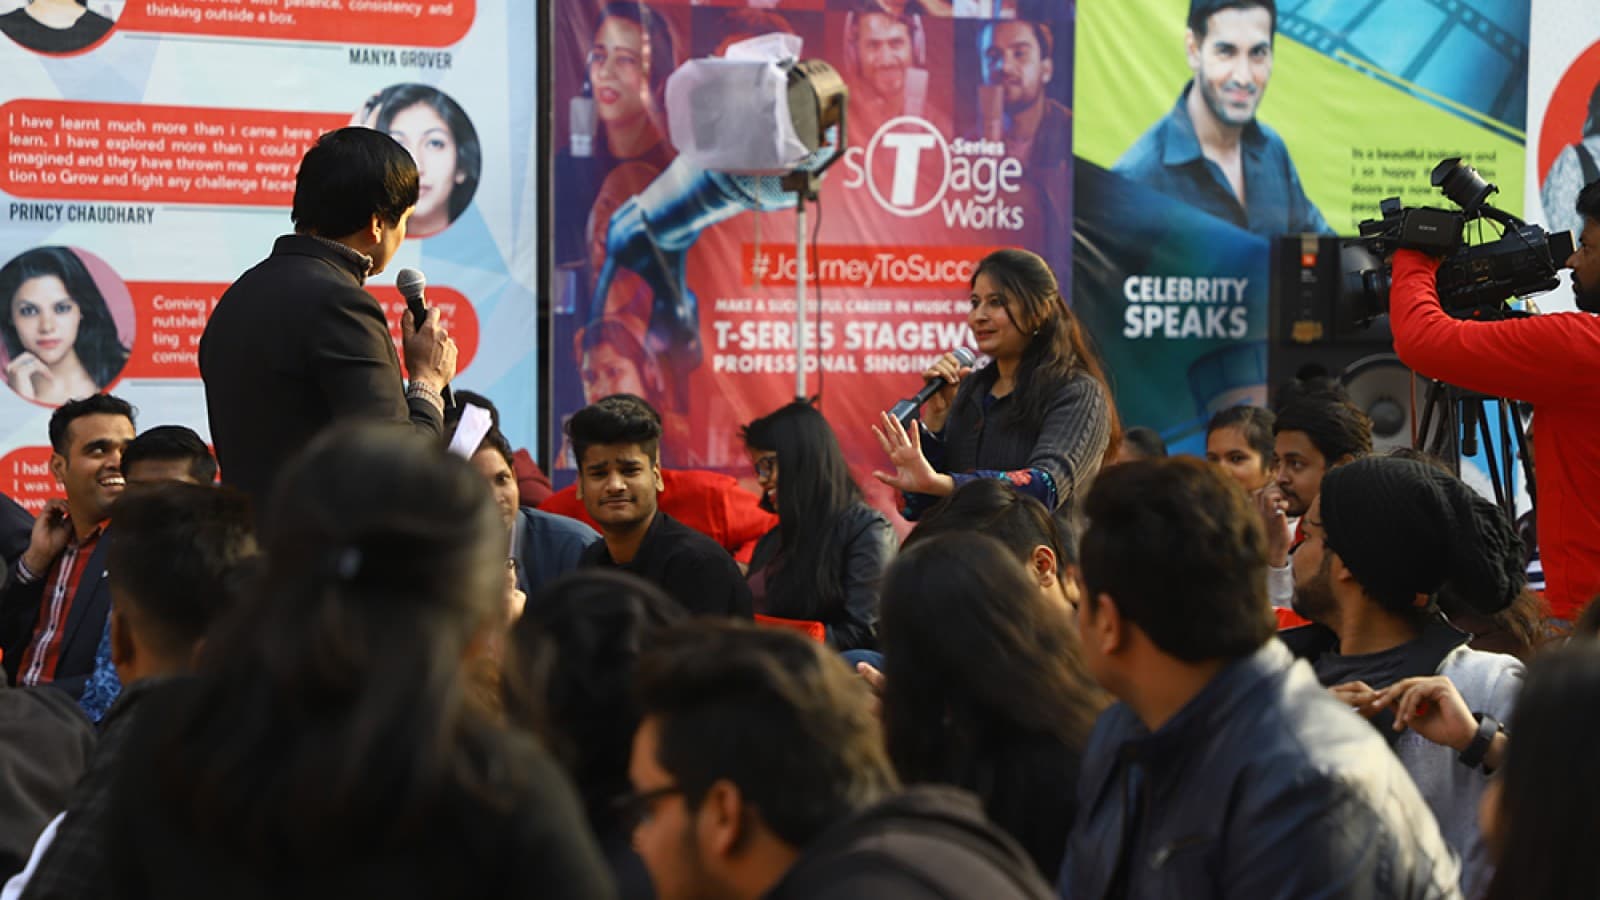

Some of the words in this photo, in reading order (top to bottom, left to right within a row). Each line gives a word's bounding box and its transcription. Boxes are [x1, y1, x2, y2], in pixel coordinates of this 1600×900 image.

[146, 3, 202, 23] thinking
[205, 8, 255, 23] outside
[257, 12, 266, 23] a
[268, 9, 297, 25] box.
[428, 4, 453, 15] and
[349, 48, 397, 66] MANYA
[400, 51, 453, 69] GROVER
[9, 112, 14, 127] I
[21, 113, 54, 129] have
[60, 115, 100, 131] learnt
[107, 118, 146, 133] much
[152, 122, 187, 135] more
[194, 122, 224, 136] than
[231, 122, 235, 136] i
[241, 127, 277, 138] came
[283, 126, 312, 139] here
[9, 131, 48, 147] learn.
[67, 133, 99, 149] have
[106, 137, 166, 154] explored
[171, 140, 206, 153] more
[213, 140, 242, 155] than
[260, 143, 296, 157] could
[9, 152, 74, 169] imagined
[77, 154, 103, 167] and
[107, 154, 137, 171] they
[141, 155, 173, 170] have
[176, 157, 223, 171] thrown
[227, 161, 248, 172] me
[255, 162, 289, 177] every
[9, 169, 37, 183] tion
[41, 170, 56, 184] to
[60, 170, 98, 185] Grow
[103, 173, 128, 186] and
[132, 173, 164, 191] fight
[168, 176, 191, 192] any
[195, 176, 258, 195] challenge
[9, 203, 63, 222] PRINCY
[67, 205, 155, 224] CHAUDHARY
[941, 199, 1024, 230] Works
[1123, 275, 1249, 303] CELEBRITY
[152, 294, 206, 314] Coming
[755, 299, 766, 313] A
[913, 300, 952, 315] MUSIC
[1123, 304, 1249, 339] SPEAKS
[152, 331, 180, 350] ting
[713, 320, 834, 350] T-SERIES
[713, 353, 857, 373] PROFESSONAL
[13, 460, 19, 475] I
[23, 460, 49, 475] had
[13, 479, 19, 493] I
[23, 482, 51, 493] was
